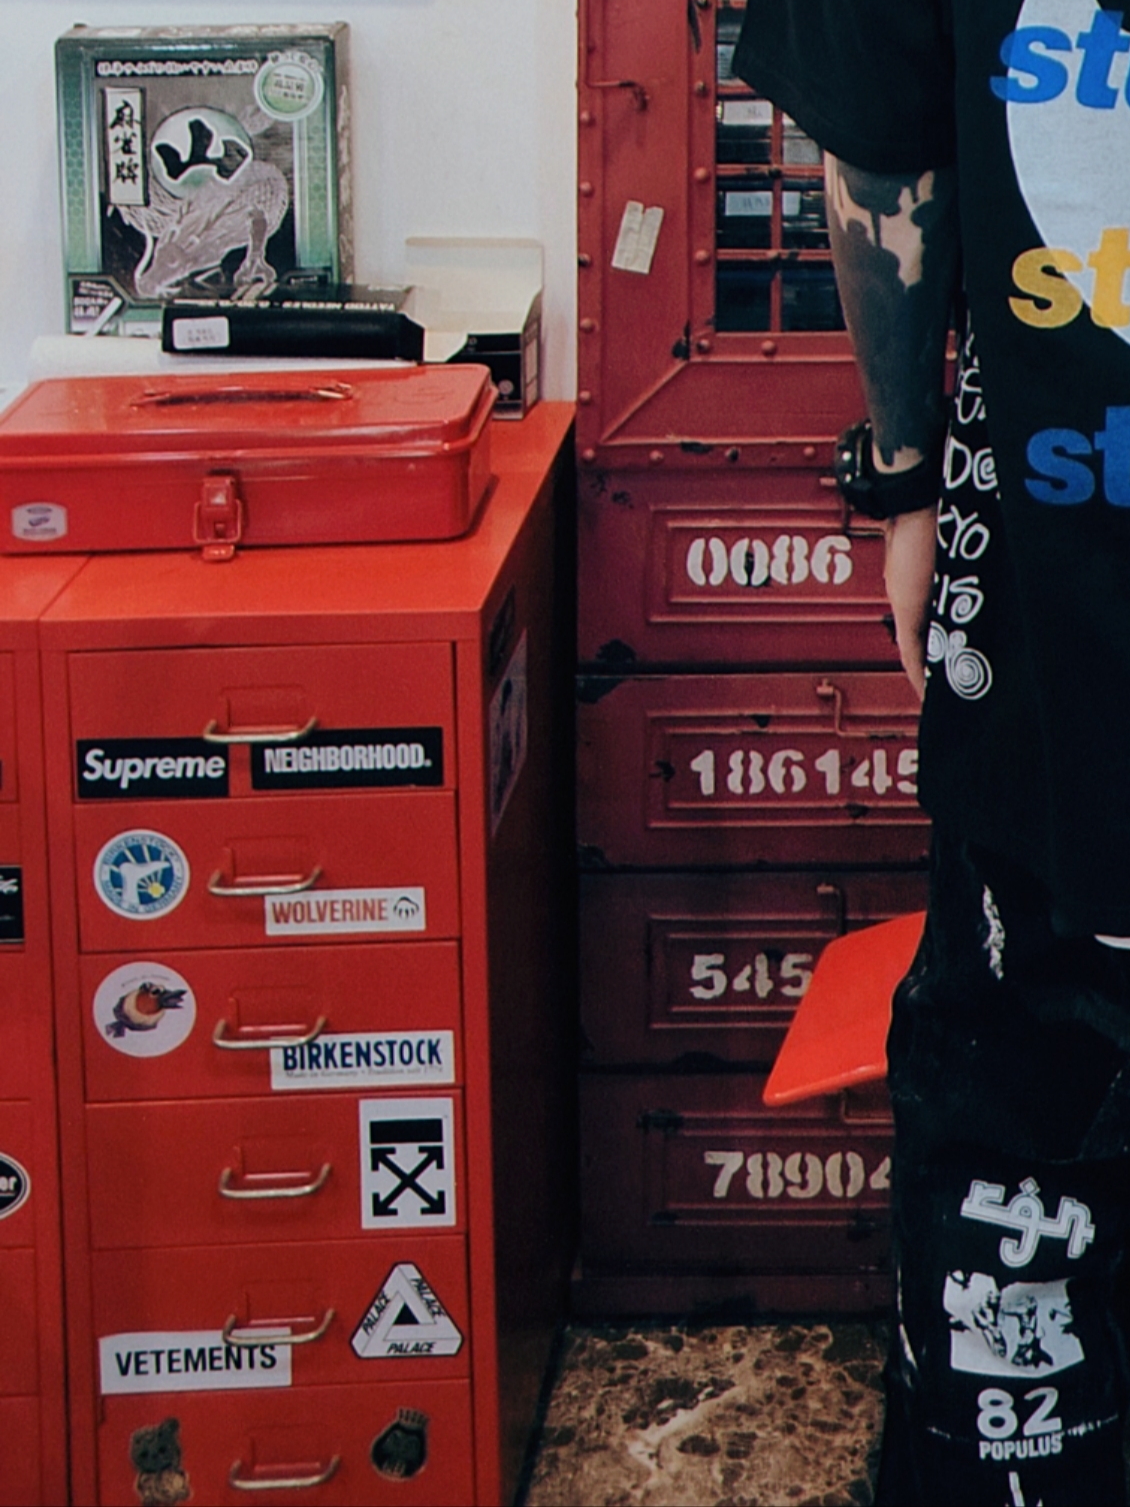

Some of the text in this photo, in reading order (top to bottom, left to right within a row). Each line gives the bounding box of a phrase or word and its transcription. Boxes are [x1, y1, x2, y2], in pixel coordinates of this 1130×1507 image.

[686, 535, 853, 587] 0086
[83, 749, 226, 789] Supreme
[271, 898, 389, 925] WOLVERINE
[283, 1038, 443, 1072] BIRKENSTOCK
[361, 1290, 391, 1337] PALACE
[410, 1277, 447, 1320] PALACE
[115, 1344, 278, 1378] VETEMENTS
[386, 1340, 437, 1354] PALACE
[976, 1386, 1063, 1440] 82
[979, 1433, 1065, 1461] POPULUS
